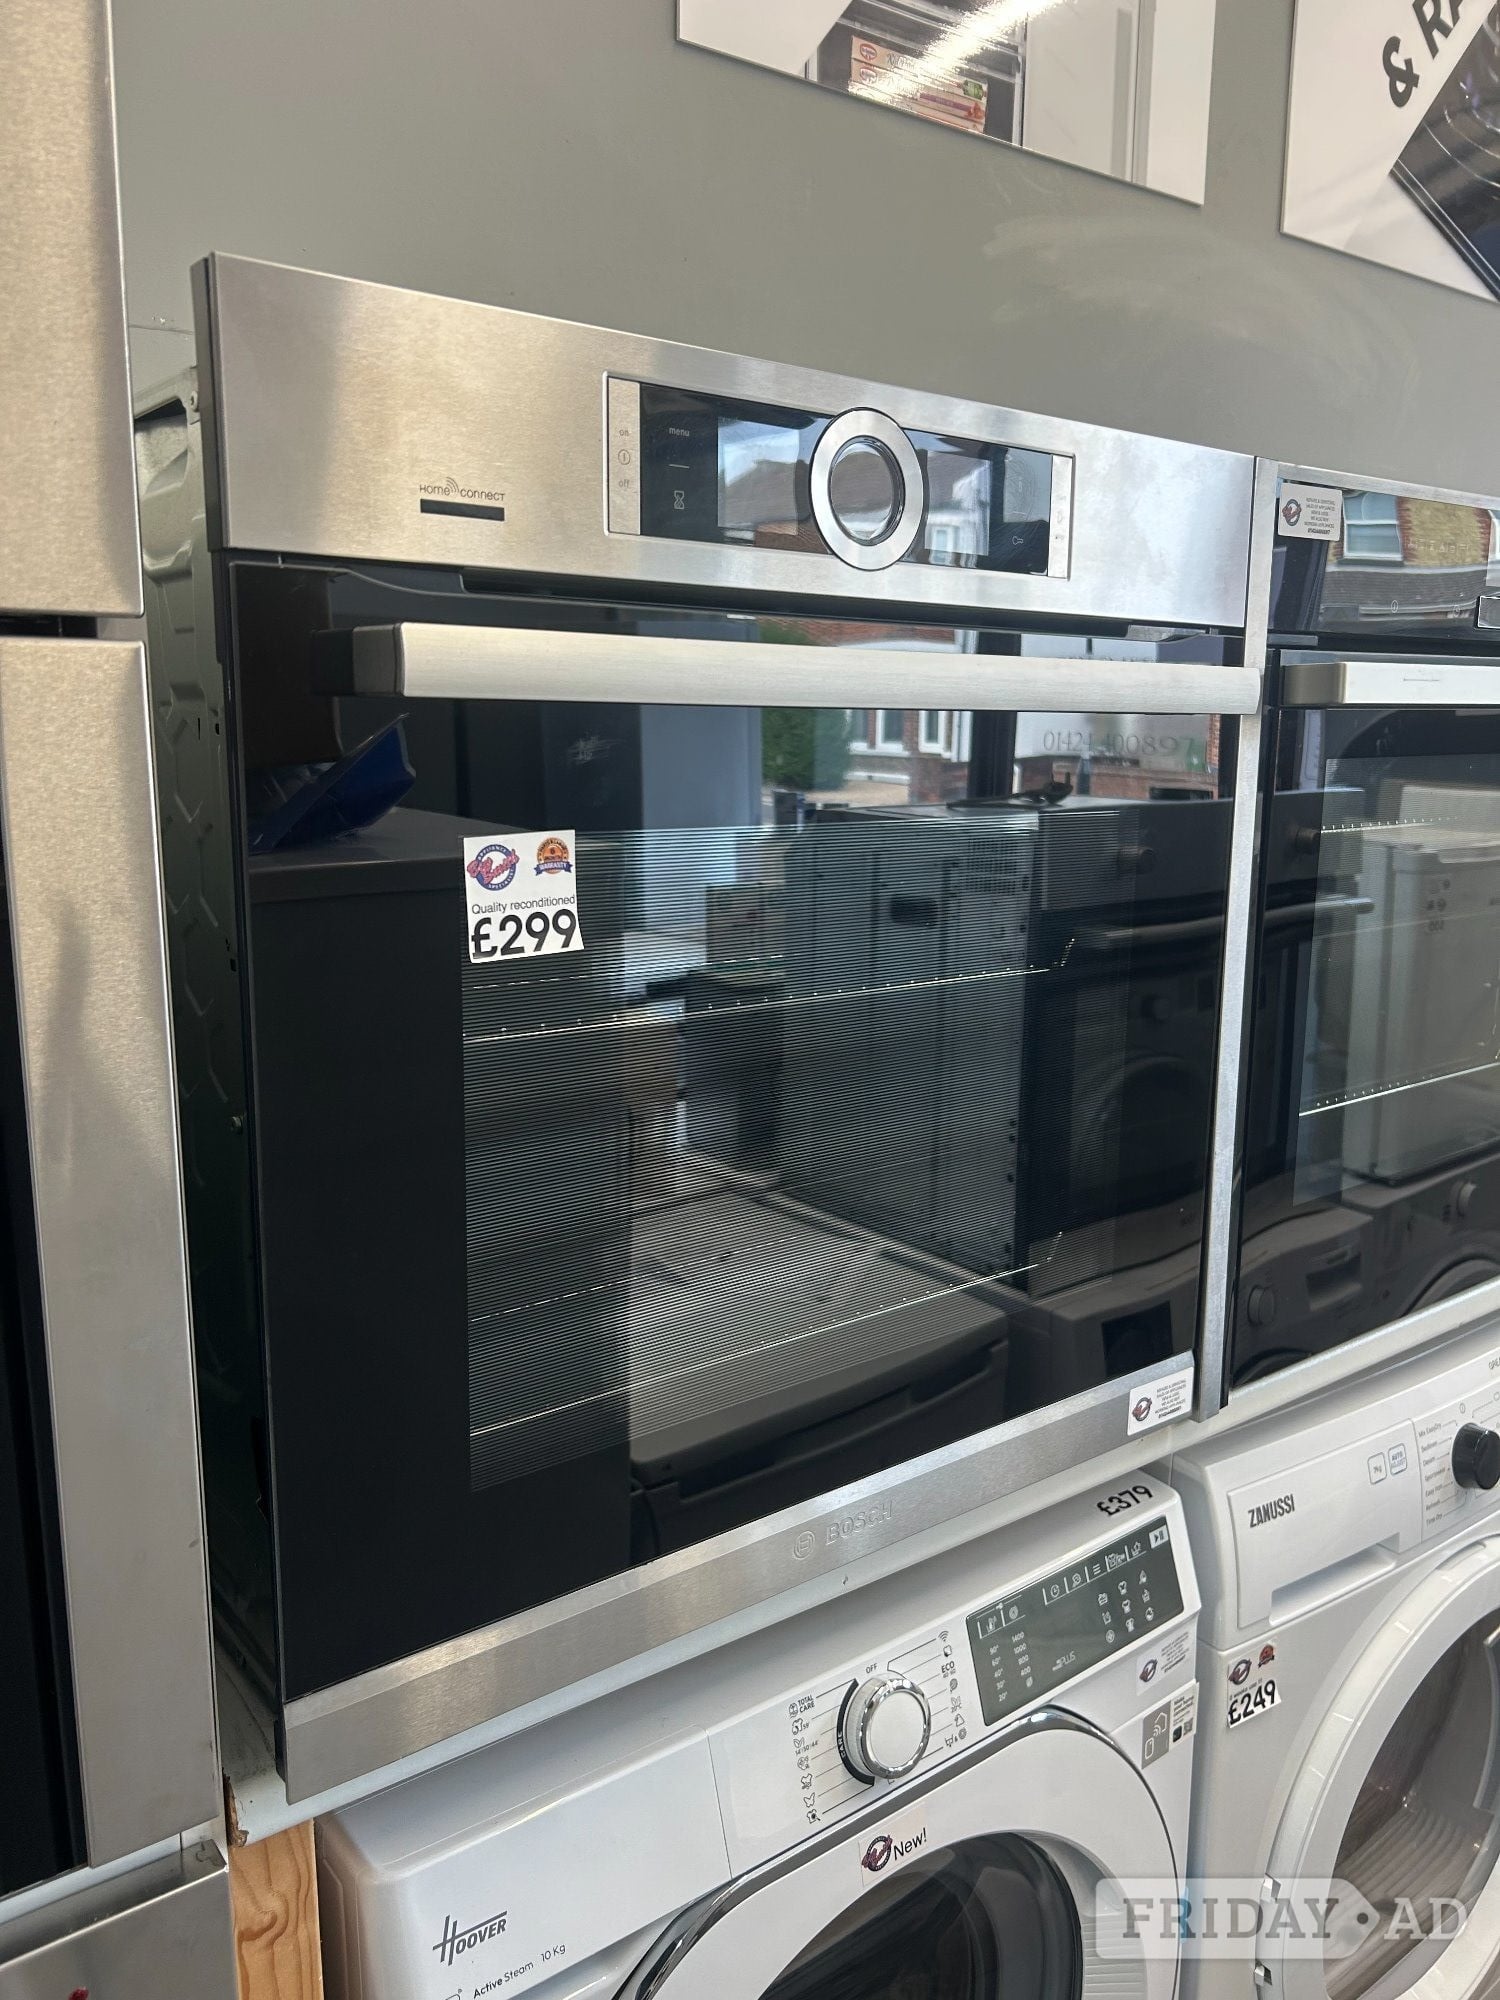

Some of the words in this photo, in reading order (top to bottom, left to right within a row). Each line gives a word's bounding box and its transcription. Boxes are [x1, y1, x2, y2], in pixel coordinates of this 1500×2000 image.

[1382, 35, 1420, 108] &
[618, 428, 630, 437] on
[669, 427, 690, 438] menu
[618, 478, 630, 488] off
[471, 901, 508, 915] Quality
[510, 894, 576, 910] reconditioned
[471, 908, 577, 960] £299
[1097, 1485, 1154, 1517] £379
[1248, 1493, 1296, 1528] ZANUSSI
[825, 1500, 893, 1546] BOSCH
[865, 1662, 878, 1675] OFF
[941, 1660, 955, 1674] ECO
[797, 1694, 814, 1707] TOTAL
[799, 1701, 816, 1714] CARE
[1228, 1679, 1276, 1726] £249
[893, 1827, 927, 1861] New!
[473, 1976, 503, 1999] Active
[504, 1960, 534, 1983] Steam
[540, 1949, 552, 1963] 10
[552, 1943, 567, 1957] Kg
